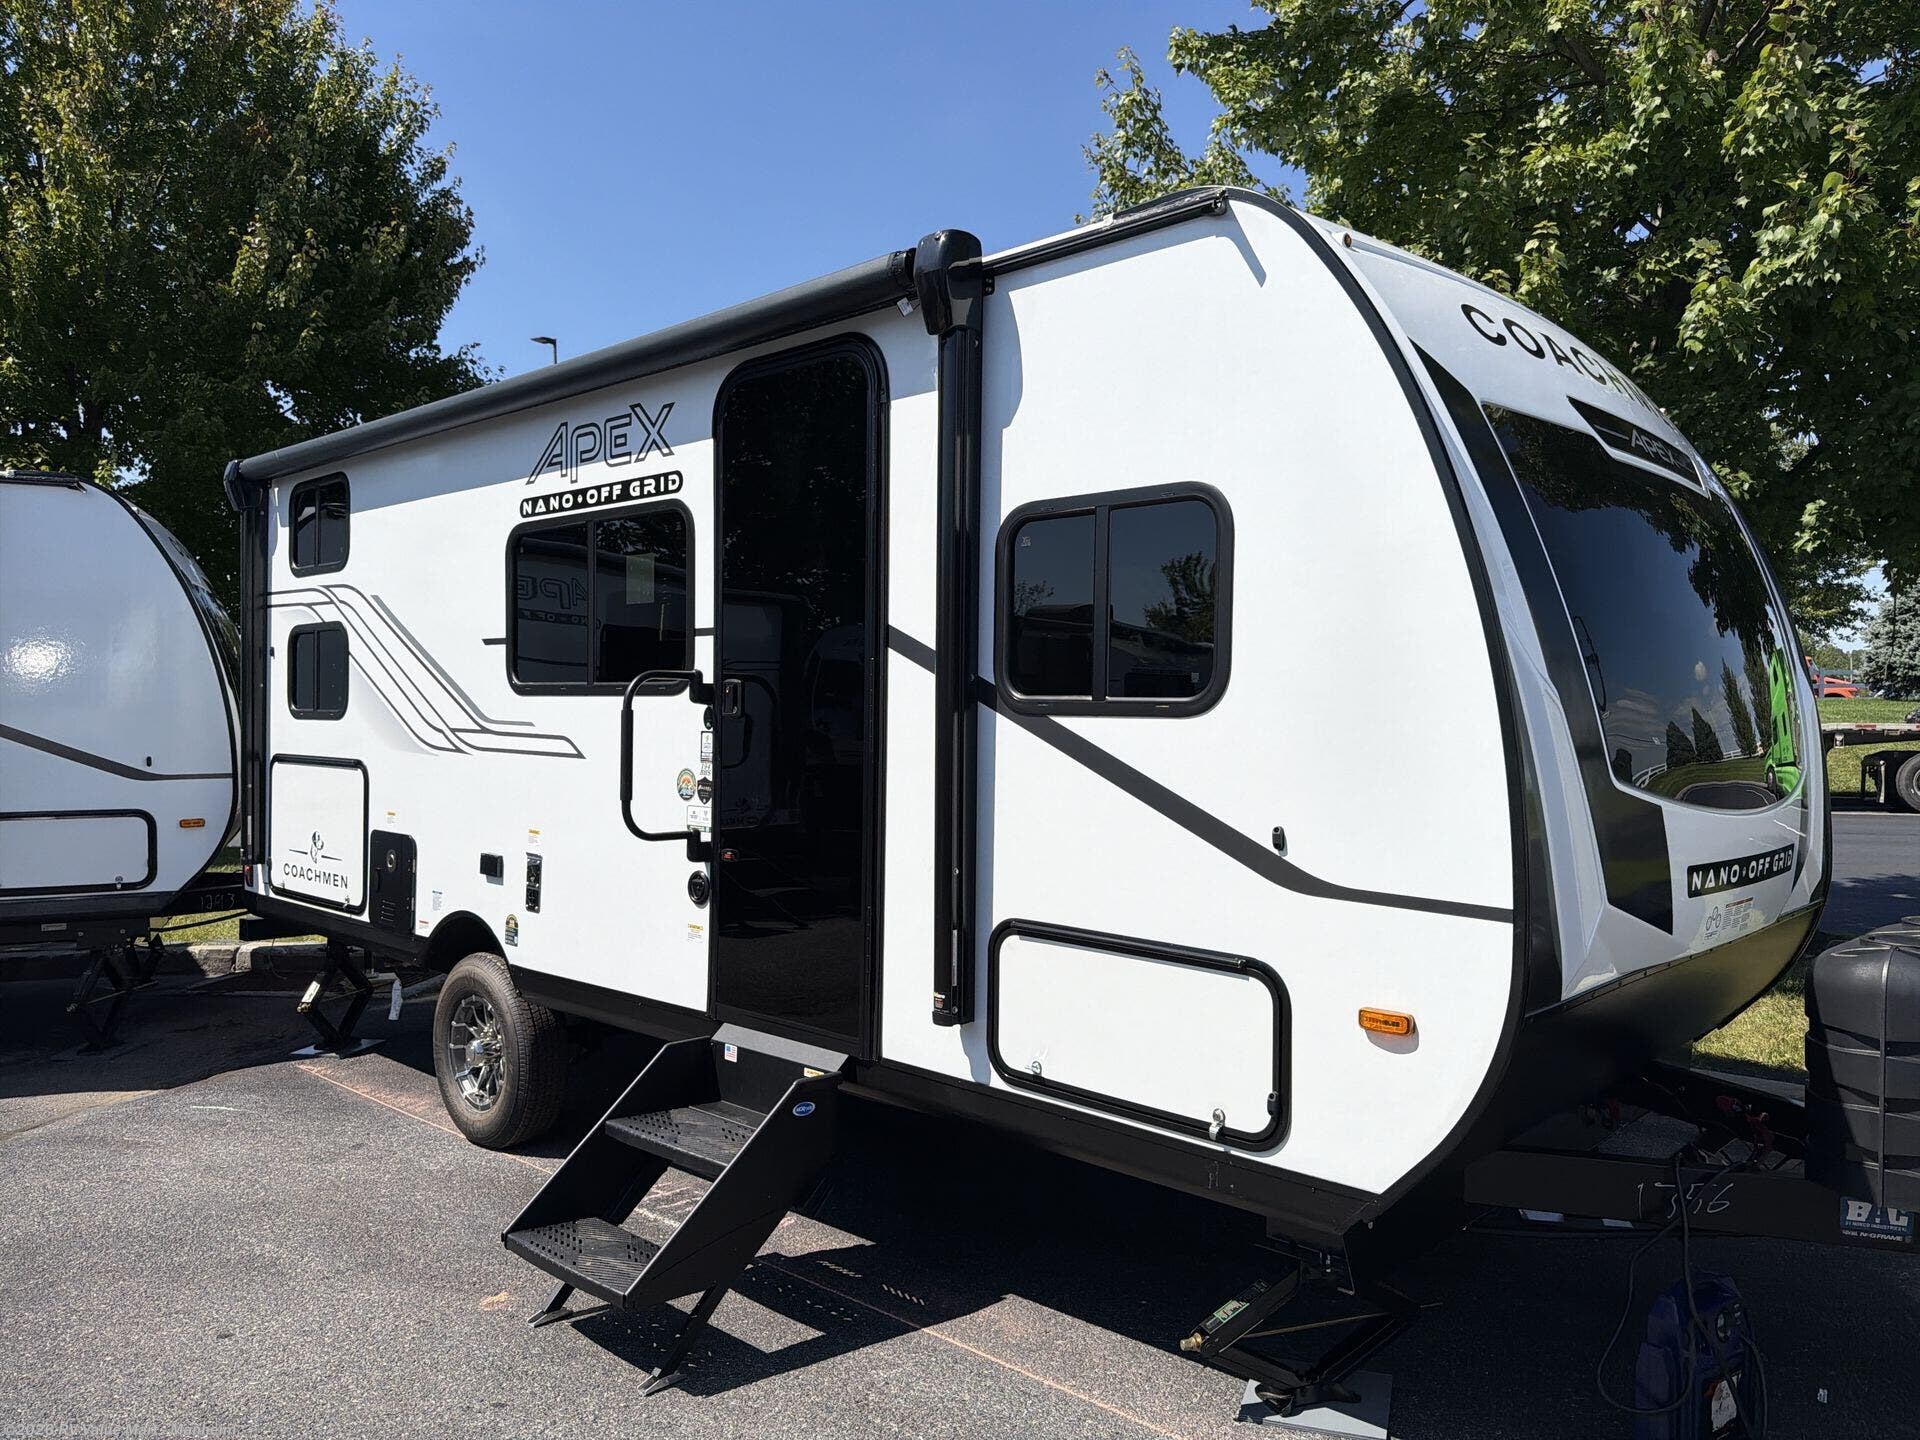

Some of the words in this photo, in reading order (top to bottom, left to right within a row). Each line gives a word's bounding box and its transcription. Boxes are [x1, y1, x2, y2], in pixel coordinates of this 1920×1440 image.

[525, 401, 676, 485] APEX
[629, 474, 680, 497] GRID
[1772, 849, 1793, 872] GRID
[283, 863, 348, 889] COACHMEN
[1846, 1200, 1909, 1227] BAL
